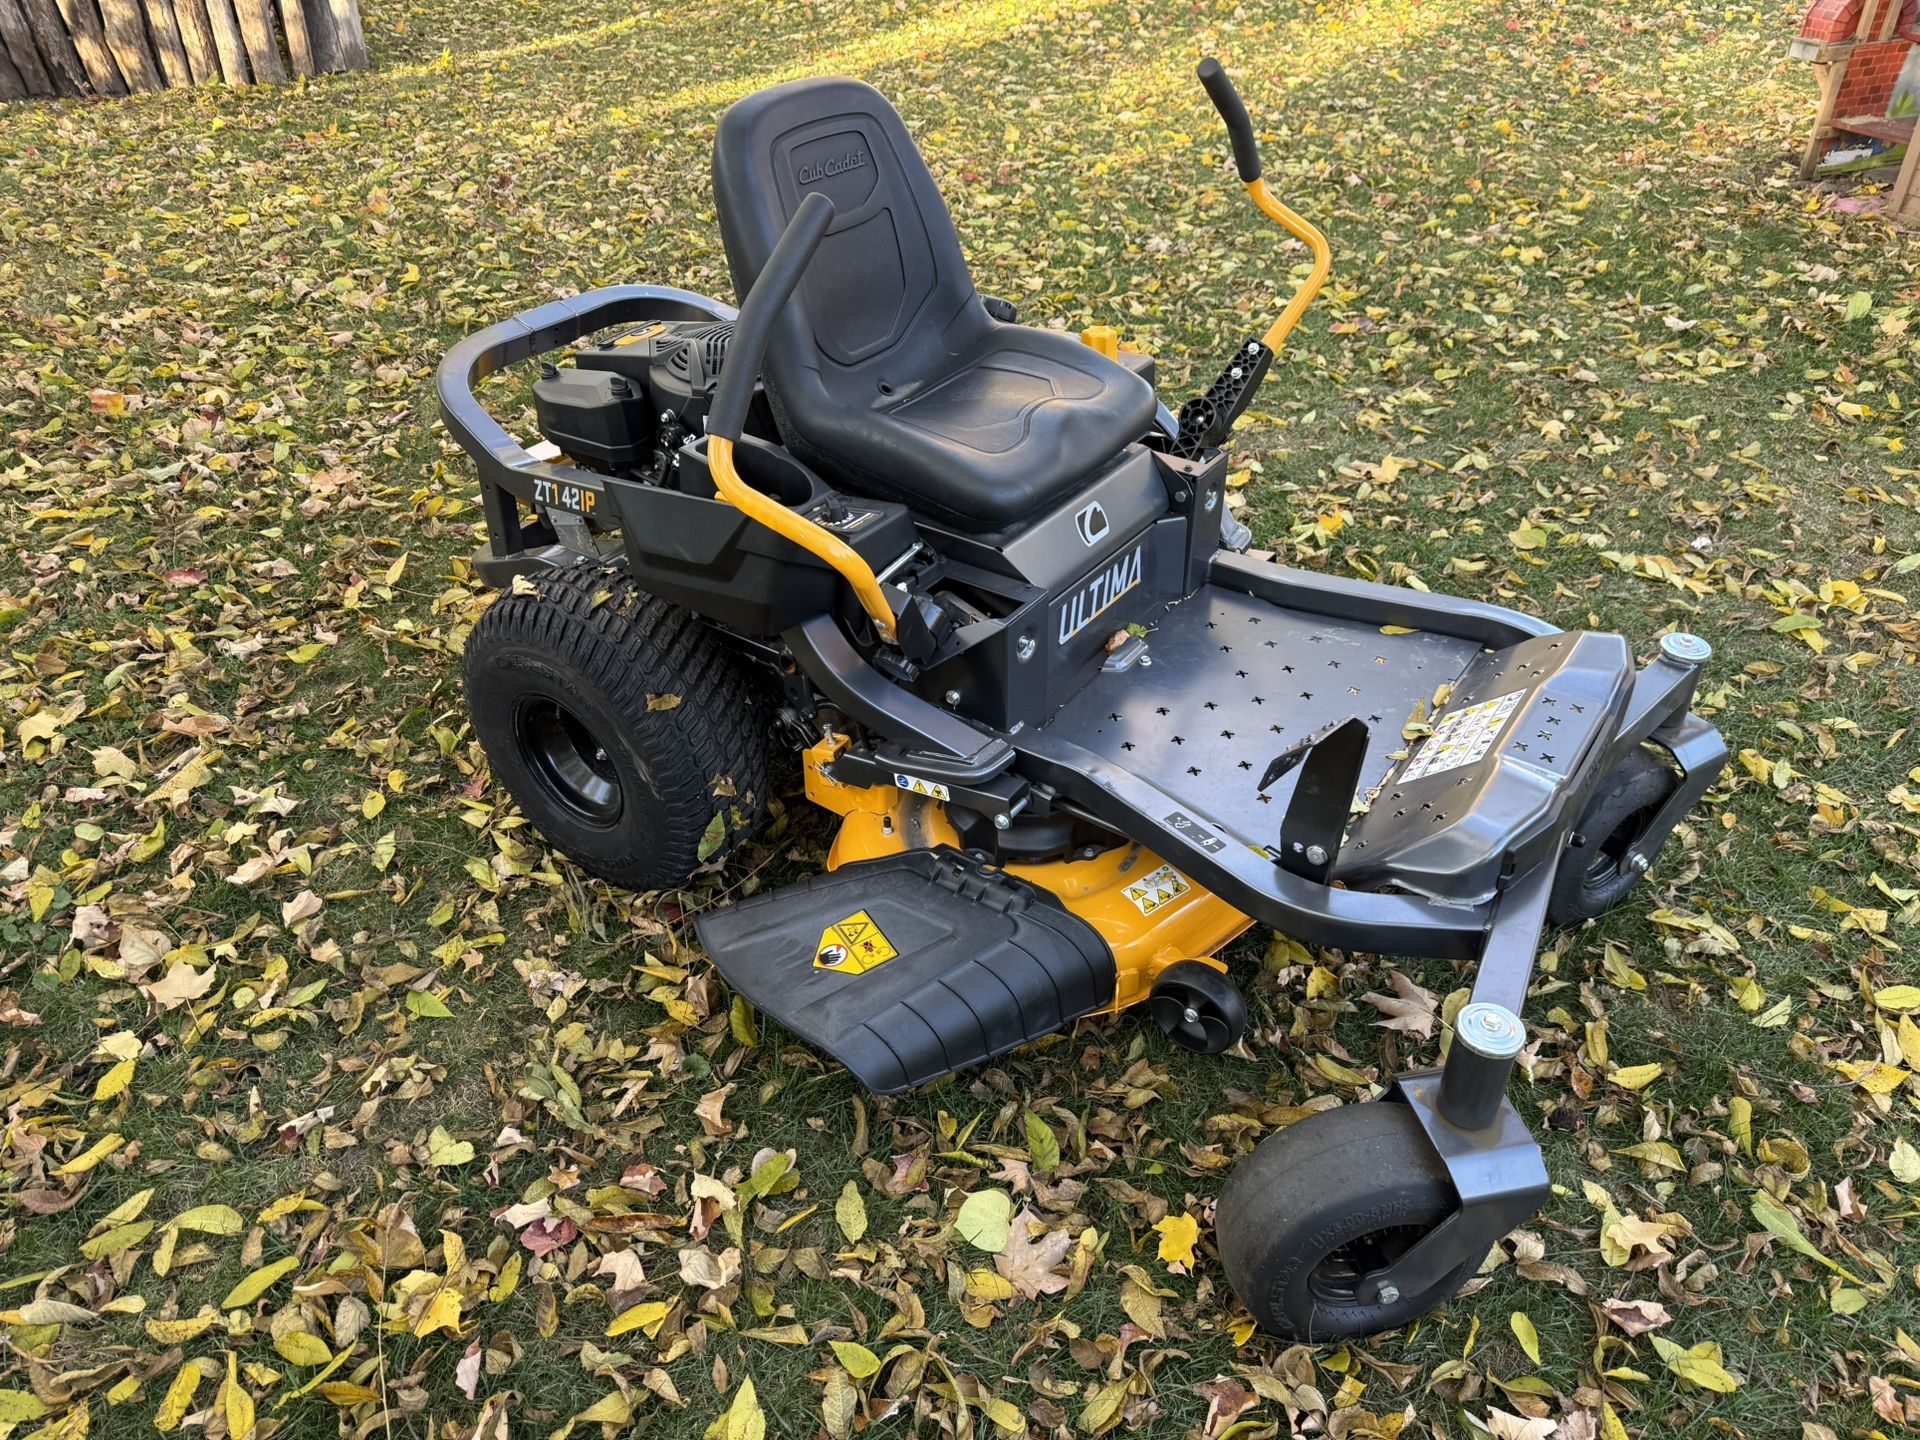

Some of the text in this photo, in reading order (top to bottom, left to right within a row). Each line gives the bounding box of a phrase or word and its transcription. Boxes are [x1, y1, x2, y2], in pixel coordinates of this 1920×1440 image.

[799, 149, 866, 185] Cub Cadet
[533, 479, 559, 505] ZT1
[1058, 545, 1142, 645] ULTIMA
